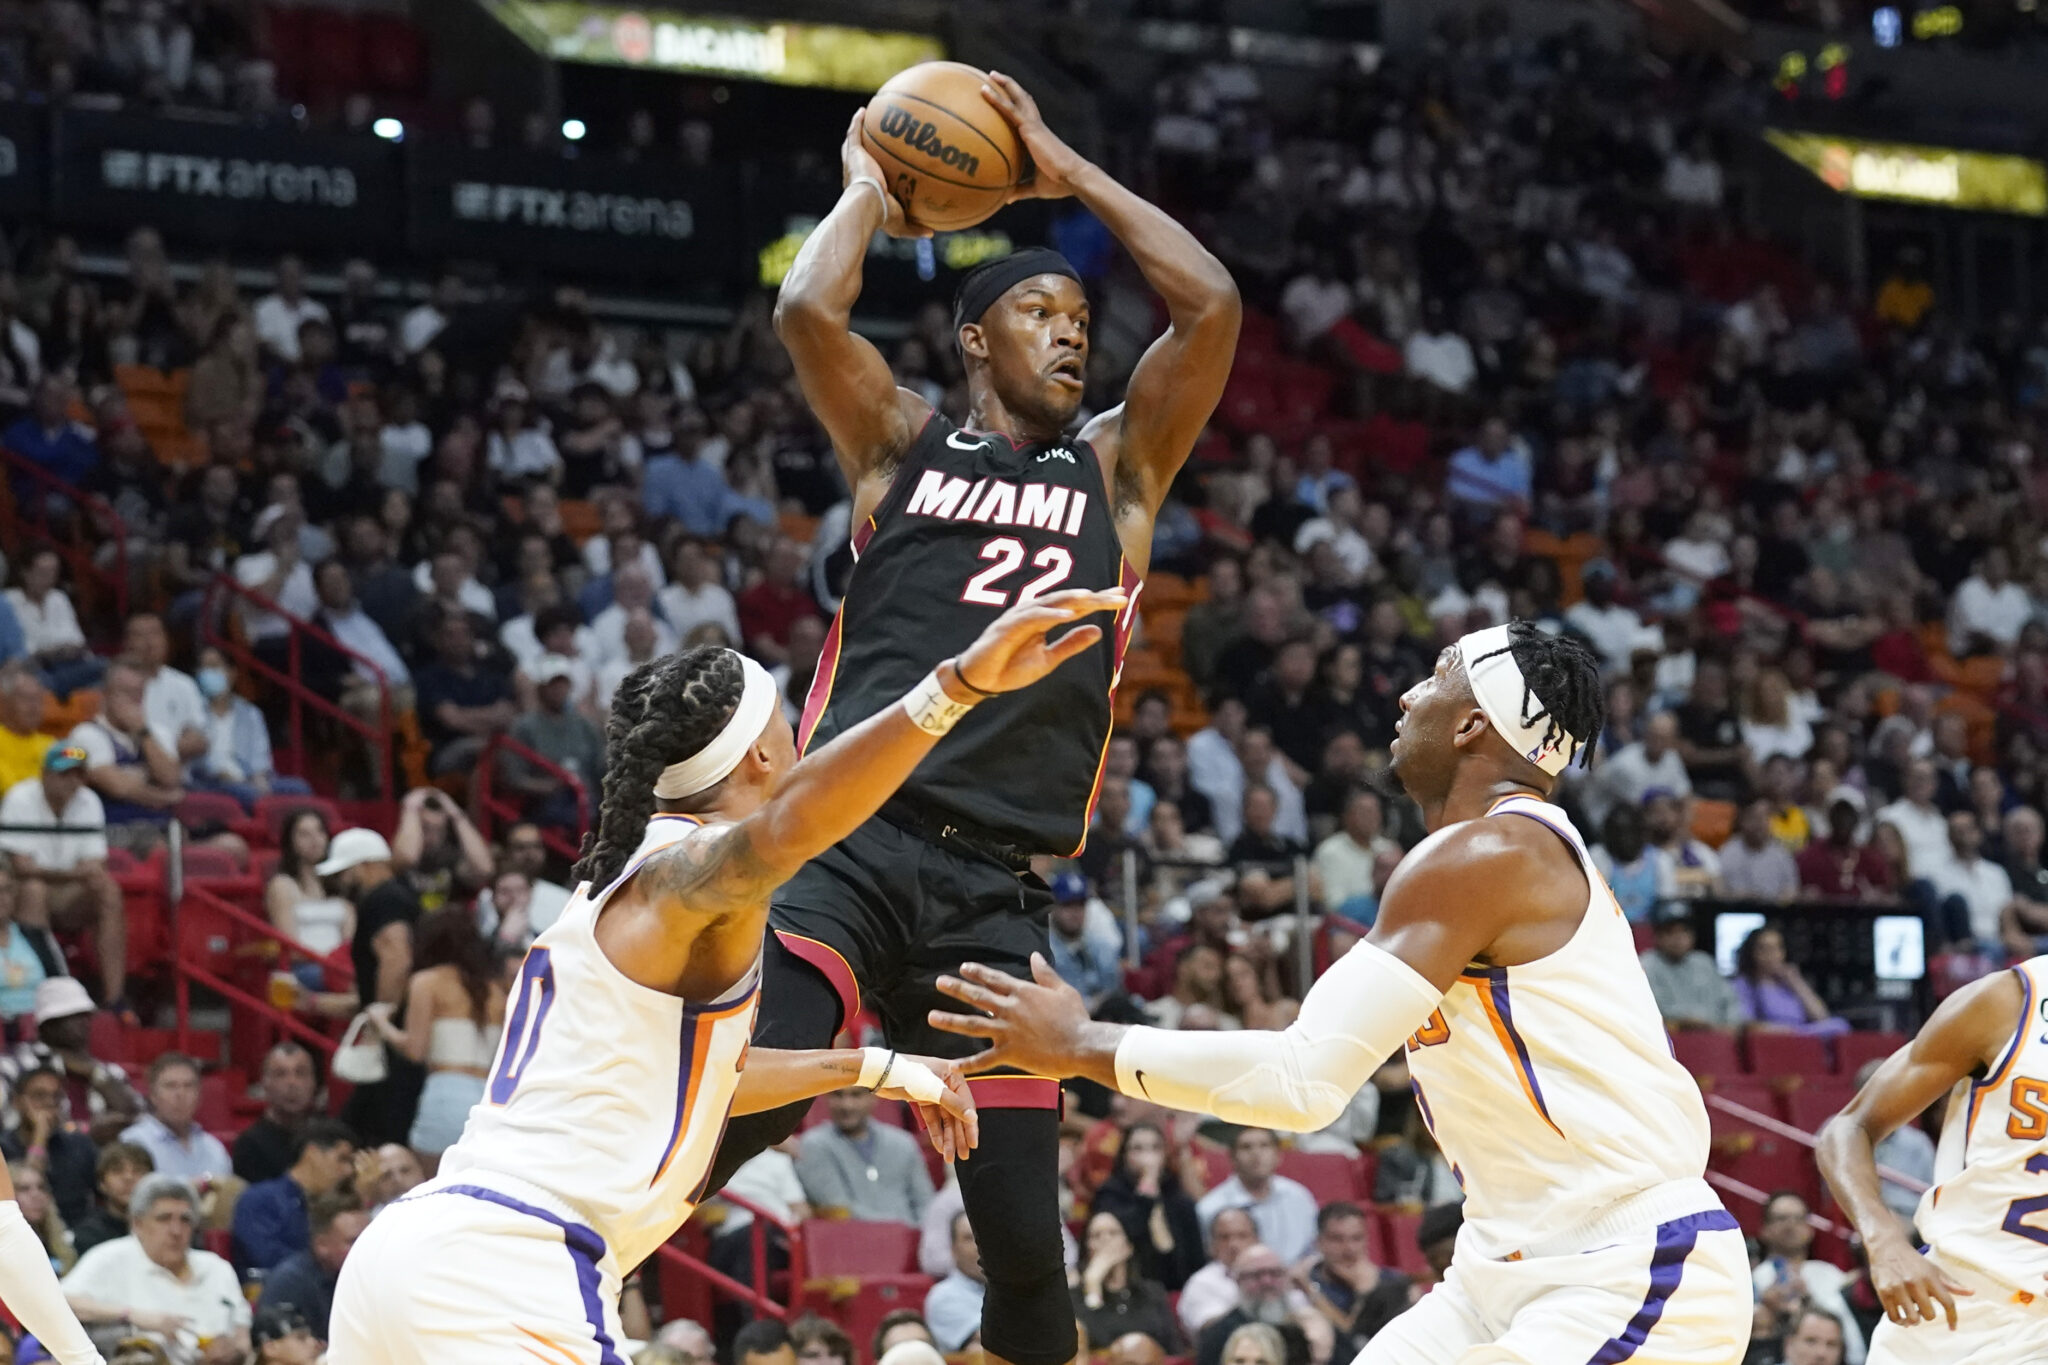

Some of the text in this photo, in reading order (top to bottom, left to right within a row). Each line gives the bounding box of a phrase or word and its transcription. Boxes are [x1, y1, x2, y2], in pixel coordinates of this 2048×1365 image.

[880, 103, 980, 178] Wilson
[904, 468, 1088, 537] MIAMI
[959, 535, 1076, 608] 22
[489, 944, 557, 1109] 0
